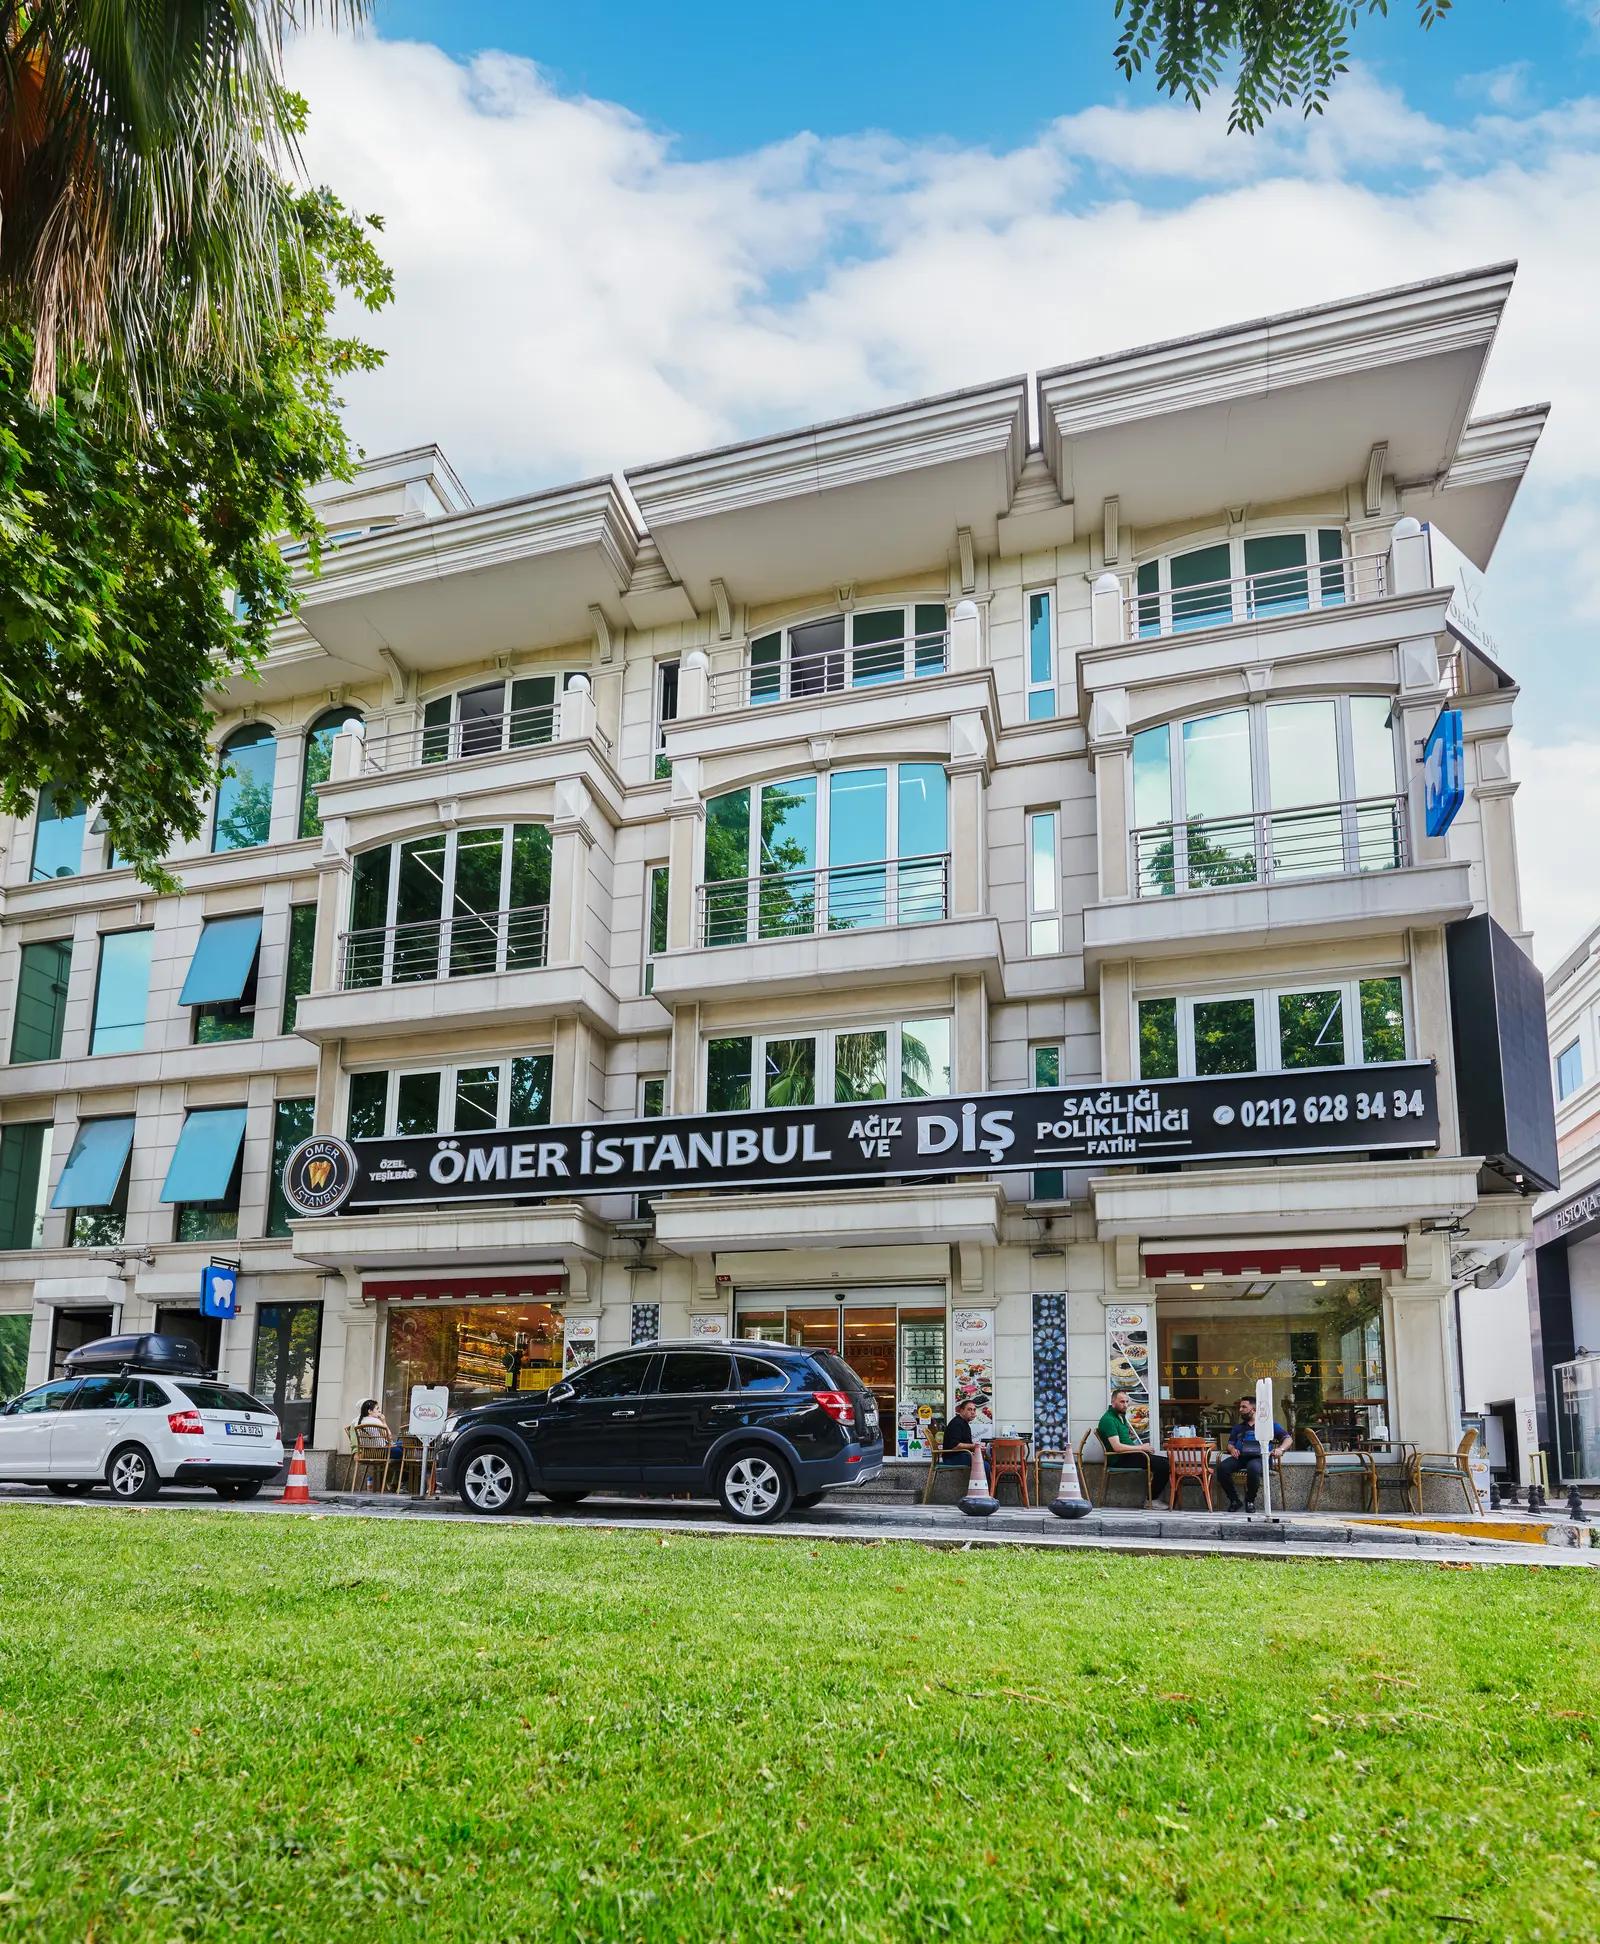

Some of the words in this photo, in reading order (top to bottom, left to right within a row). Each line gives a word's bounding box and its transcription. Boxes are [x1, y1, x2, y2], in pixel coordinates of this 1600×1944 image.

[1063, 1088, 1159, 1117] SAĞLIĞI
[1240, 1098, 1297, 1127] 0212
[1303, 1094, 1349, 1123] 628
[1356, 1091, 1386, 1120] 34
[1393, 1089, 1425, 1118] 34
[848, 1113, 902, 1138] AĞIZ
[917, 1102, 1015, 1163] DİŞ
[1037, 1108, 1189, 1139] POLİKLİNİĞİ
[429, 1140, 571, 1184] ÖMER
[580, 1124, 832, 1175] İSTANBUL
[859, 1139, 891, 1159] VE
[1087, 1136, 1136, 1155] FATİH
[380, 1159, 406, 1169] ÖZEL
[1555, 1193, 1597, 1230] HISTORIA
[230, 1425, 238, 1433] 34
